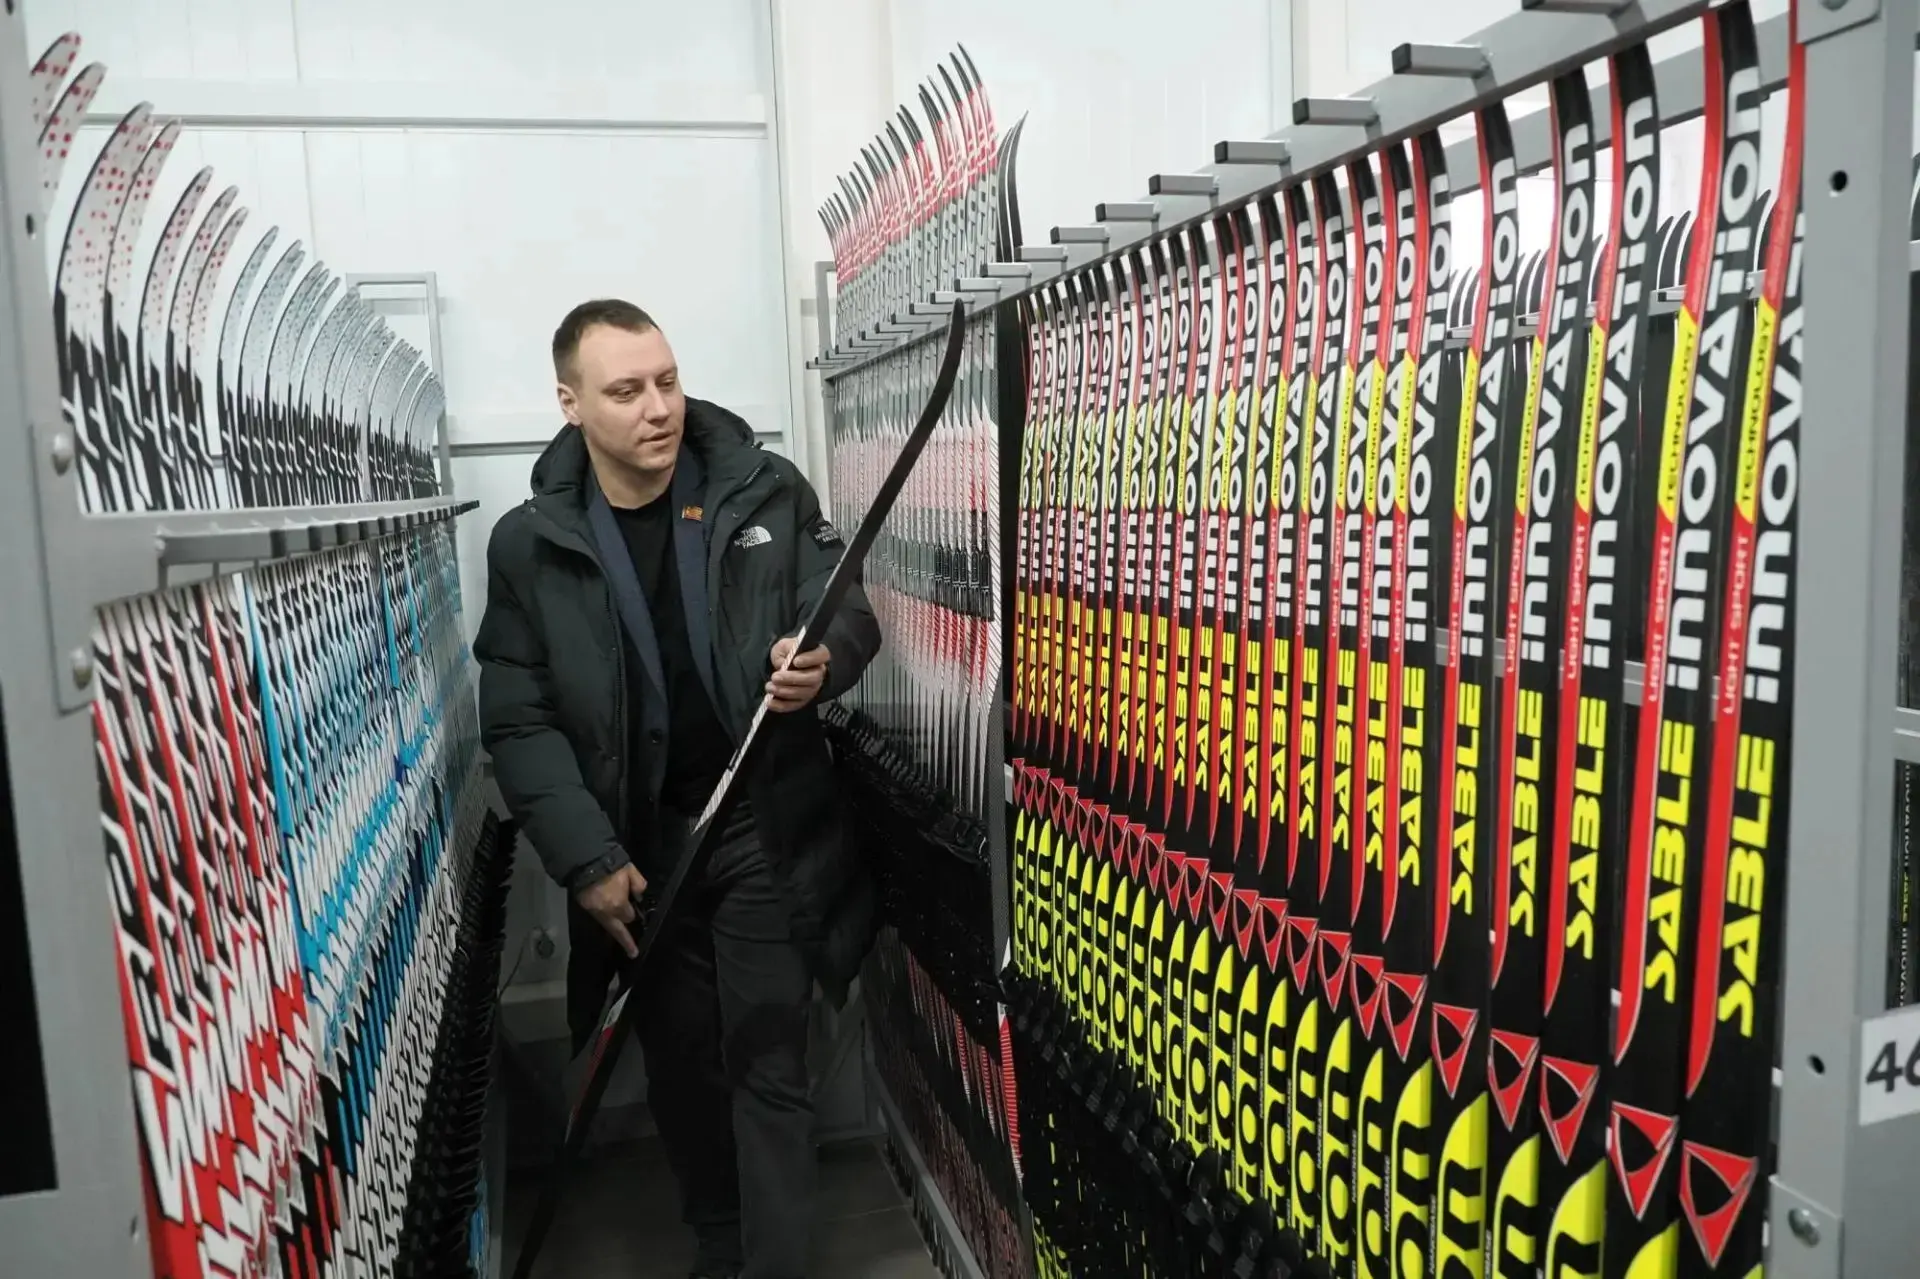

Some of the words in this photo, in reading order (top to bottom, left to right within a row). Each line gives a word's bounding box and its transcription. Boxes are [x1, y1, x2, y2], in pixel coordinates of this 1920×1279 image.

[1519, 352, 1540, 498] TECHNOLOGY
[1580, 339, 1600, 495] TECHNOLOGY
[1666, 332, 1693, 502] TECHNOLOGY
[1742, 318, 1769, 501] TECHNOLOGY
[1450, 612, 1458, 668] LIGHT
[1452, 531, 1462, 603] SPORT
[1507, 613, 1517, 673] LIGHT
[1510, 527, 1522, 604] SPORT
[1572, 525, 1586, 606] SPORT
[1655, 535, 1670, 623] SPORT
[1730, 536, 1748, 630] SPORT
[1085, 607, 1094, 740] SABLE
[1100, 608, 1111, 745] SABLE
[1119, 611, 1132, 754] SABLE
[1137, 613, 1149, 763] SABLE
[1154, 616, 1167, 771] SABLE
[1175, 626, 1190, 785] SABLE
[1196, 626, 1213, 793] SABLE
[1220, 631, 1235, 801] SABLE
[1567, 616, 1579, 679] LIGHT
[1648, 634, 1663, 702] LIGHT
[1722, 642, 1740, 714] LIGHT
[1244, 640, 1260, 819] SABLE
[1271, 638, 1289, 825] SABLE
[1300, 646, 1318, 839] SABLE
[1333, 648, 1355, 850] SABLE
[1366, 660, 1387, 873] SABLE
[1399, 666, 1425, 887] SABLE
[1451, 681, 1481, 914] SABLE
[1510, 689, 1542, 937] SABLE
[1566, 696, 1606, 960] SABLE
[1644, 719, 1694, 1004] SABLE
[1718, 733, 1774, 1038] SABLE
